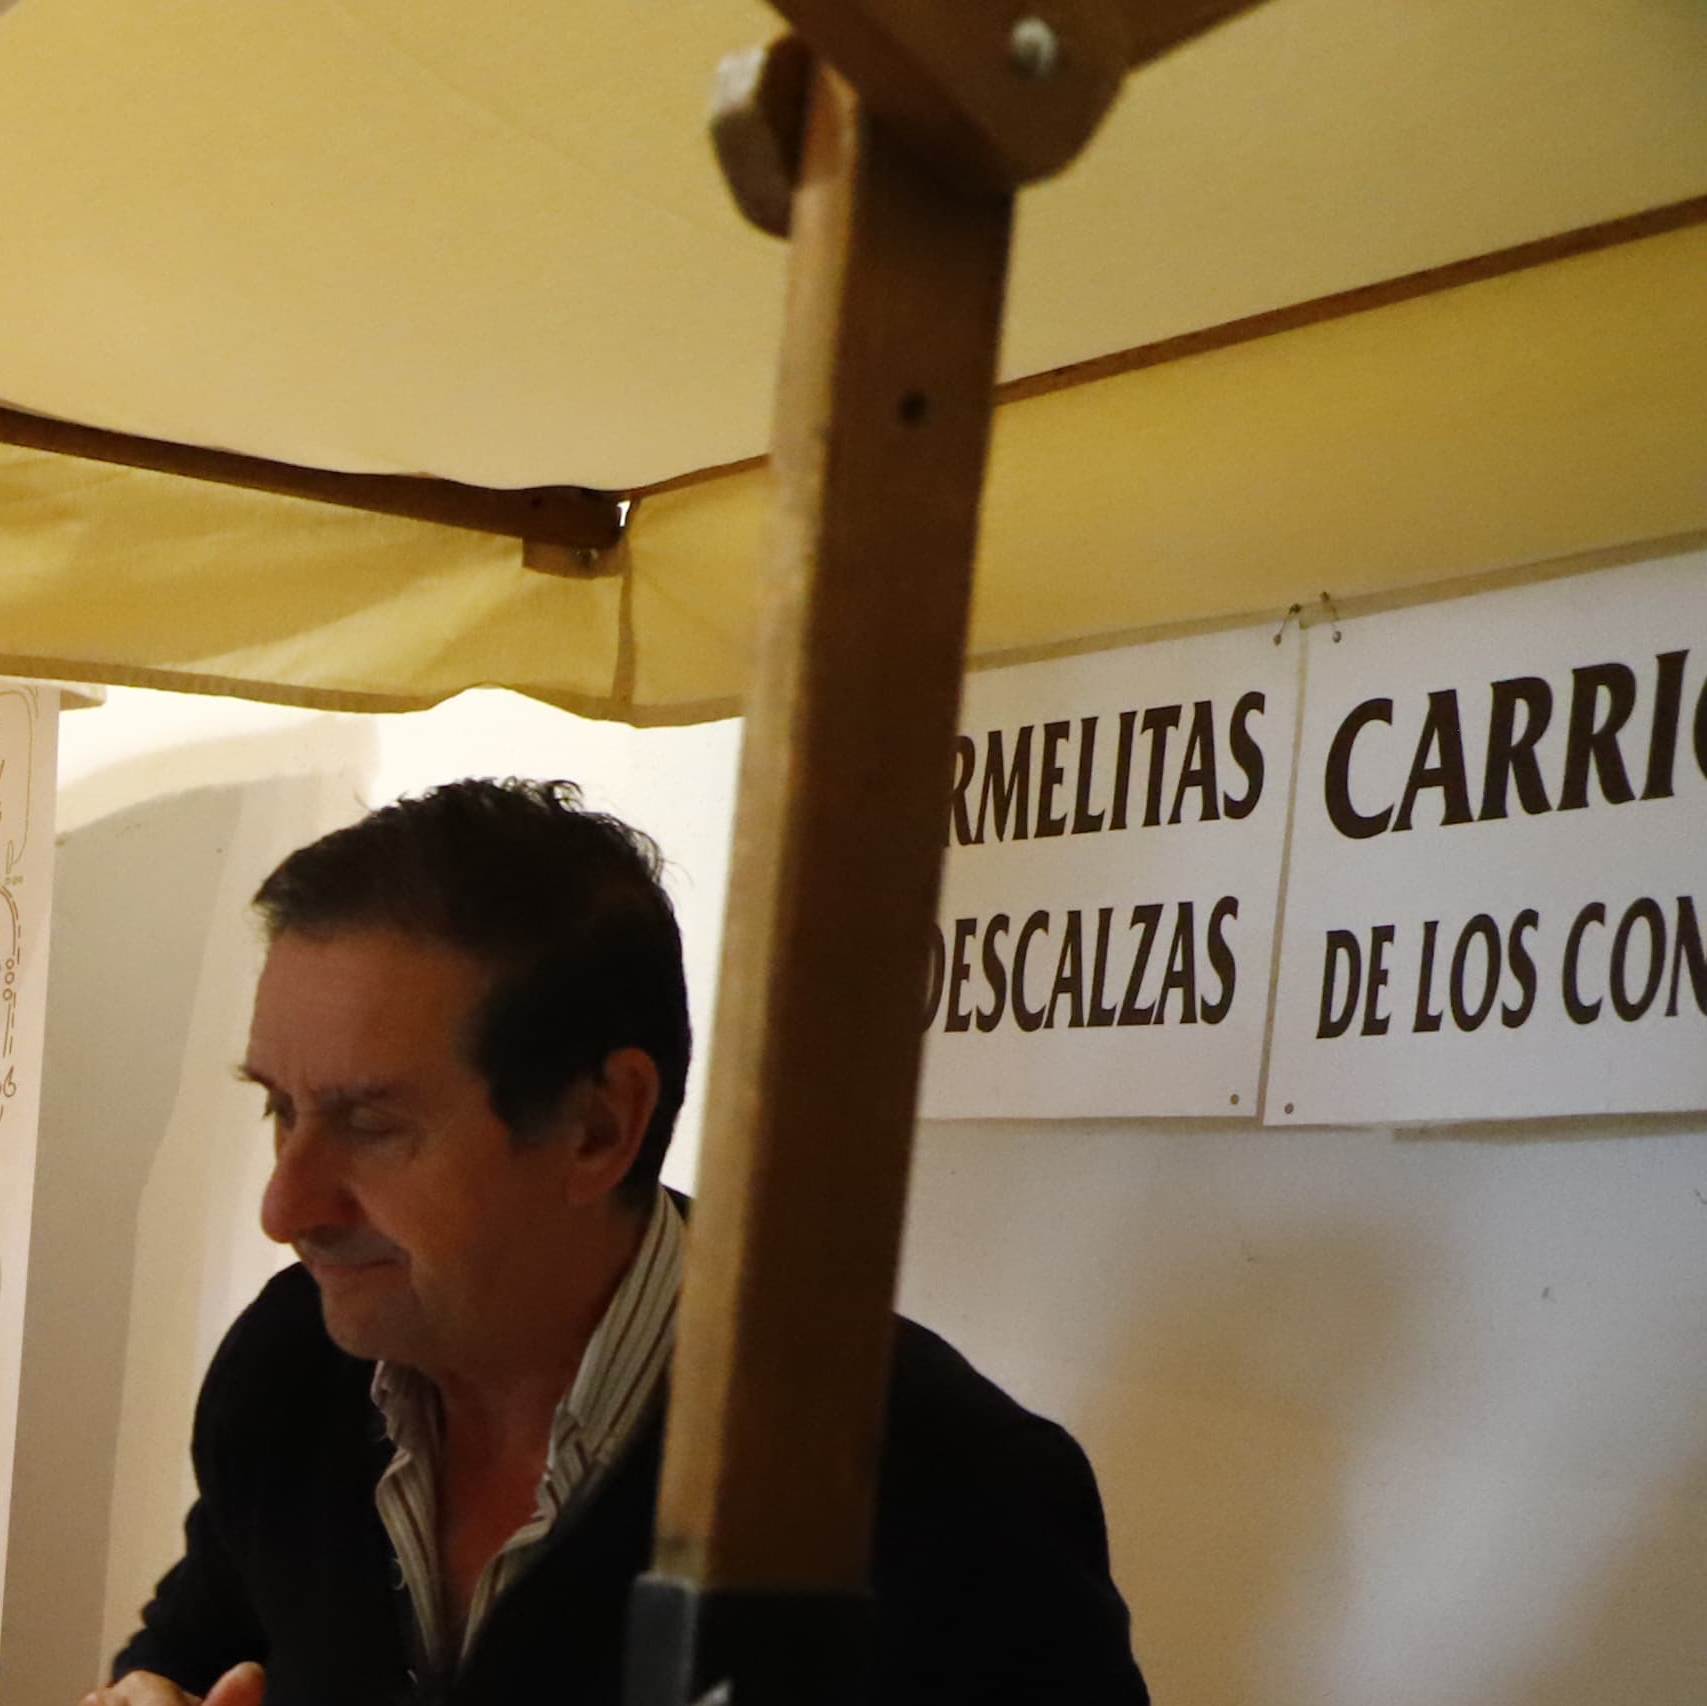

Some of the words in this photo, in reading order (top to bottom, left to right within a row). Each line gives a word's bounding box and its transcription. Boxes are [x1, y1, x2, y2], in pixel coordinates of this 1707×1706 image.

[1325, 648, 1707, 840] CARRI
[1316, 924, 1394, 1040] DE
[1413, 908, 1539, 1035] LOS
